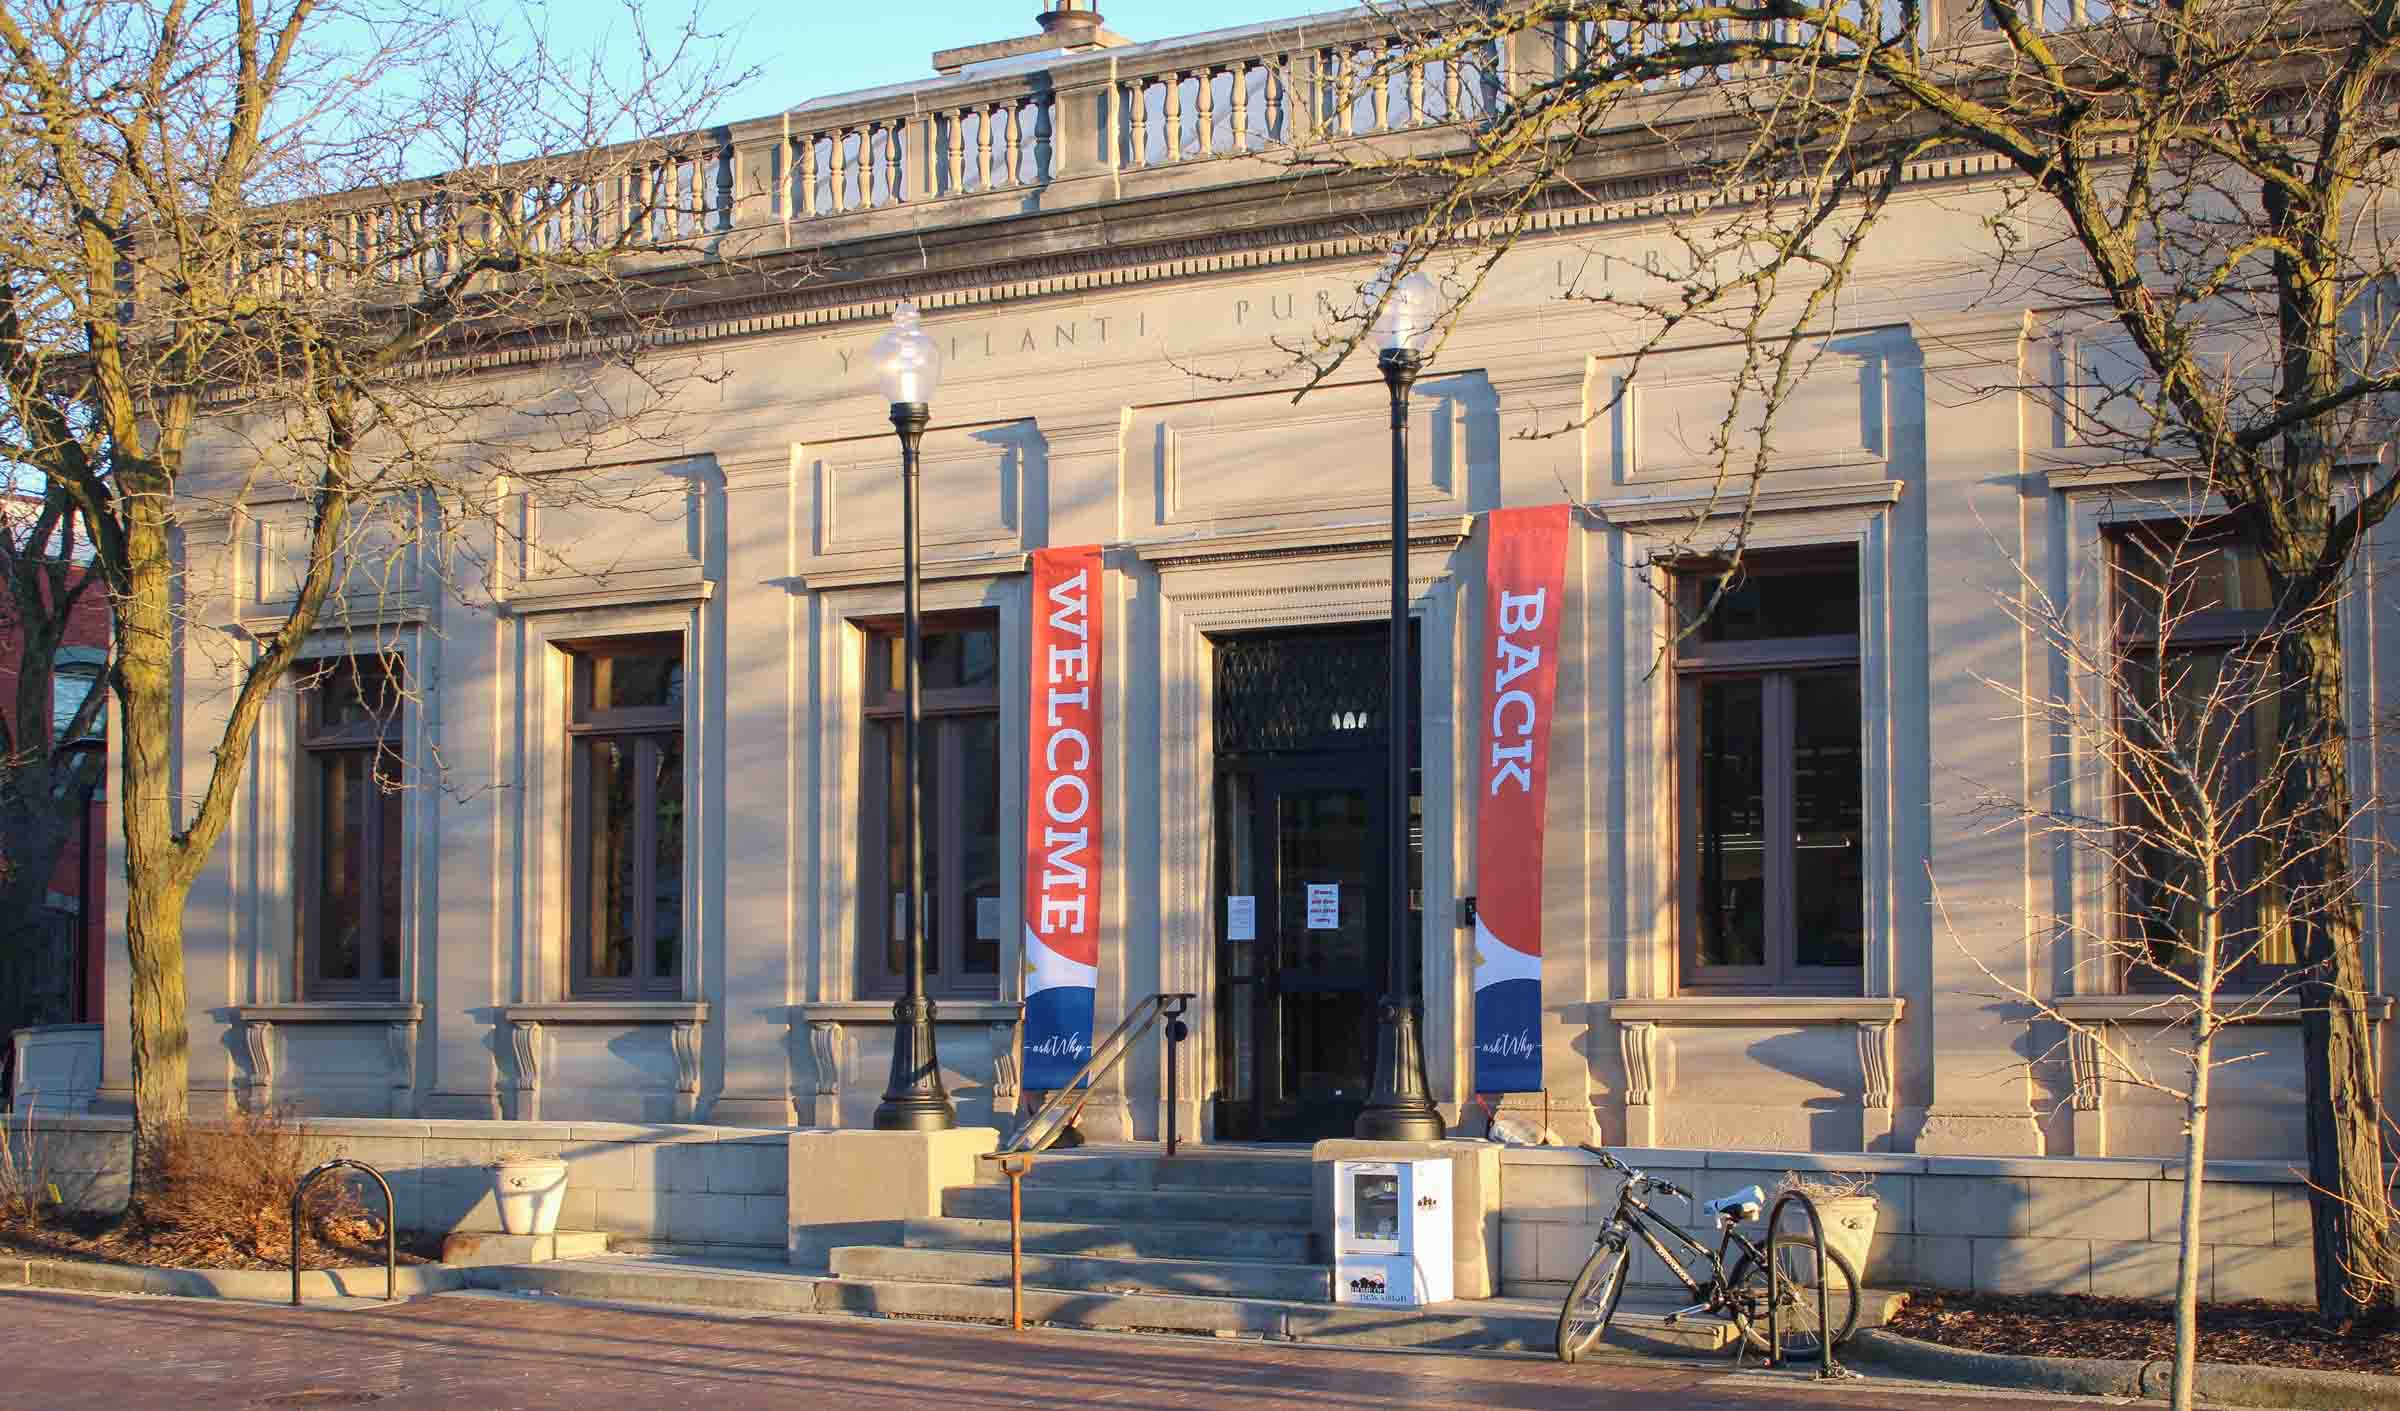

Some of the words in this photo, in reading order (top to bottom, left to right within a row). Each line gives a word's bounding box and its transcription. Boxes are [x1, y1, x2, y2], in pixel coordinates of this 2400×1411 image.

[837, 310, 1147, 375] YILANTI
[1039, 568, 1090, 934] WELCOME
[1491, 587, 1545, 796] BACK
